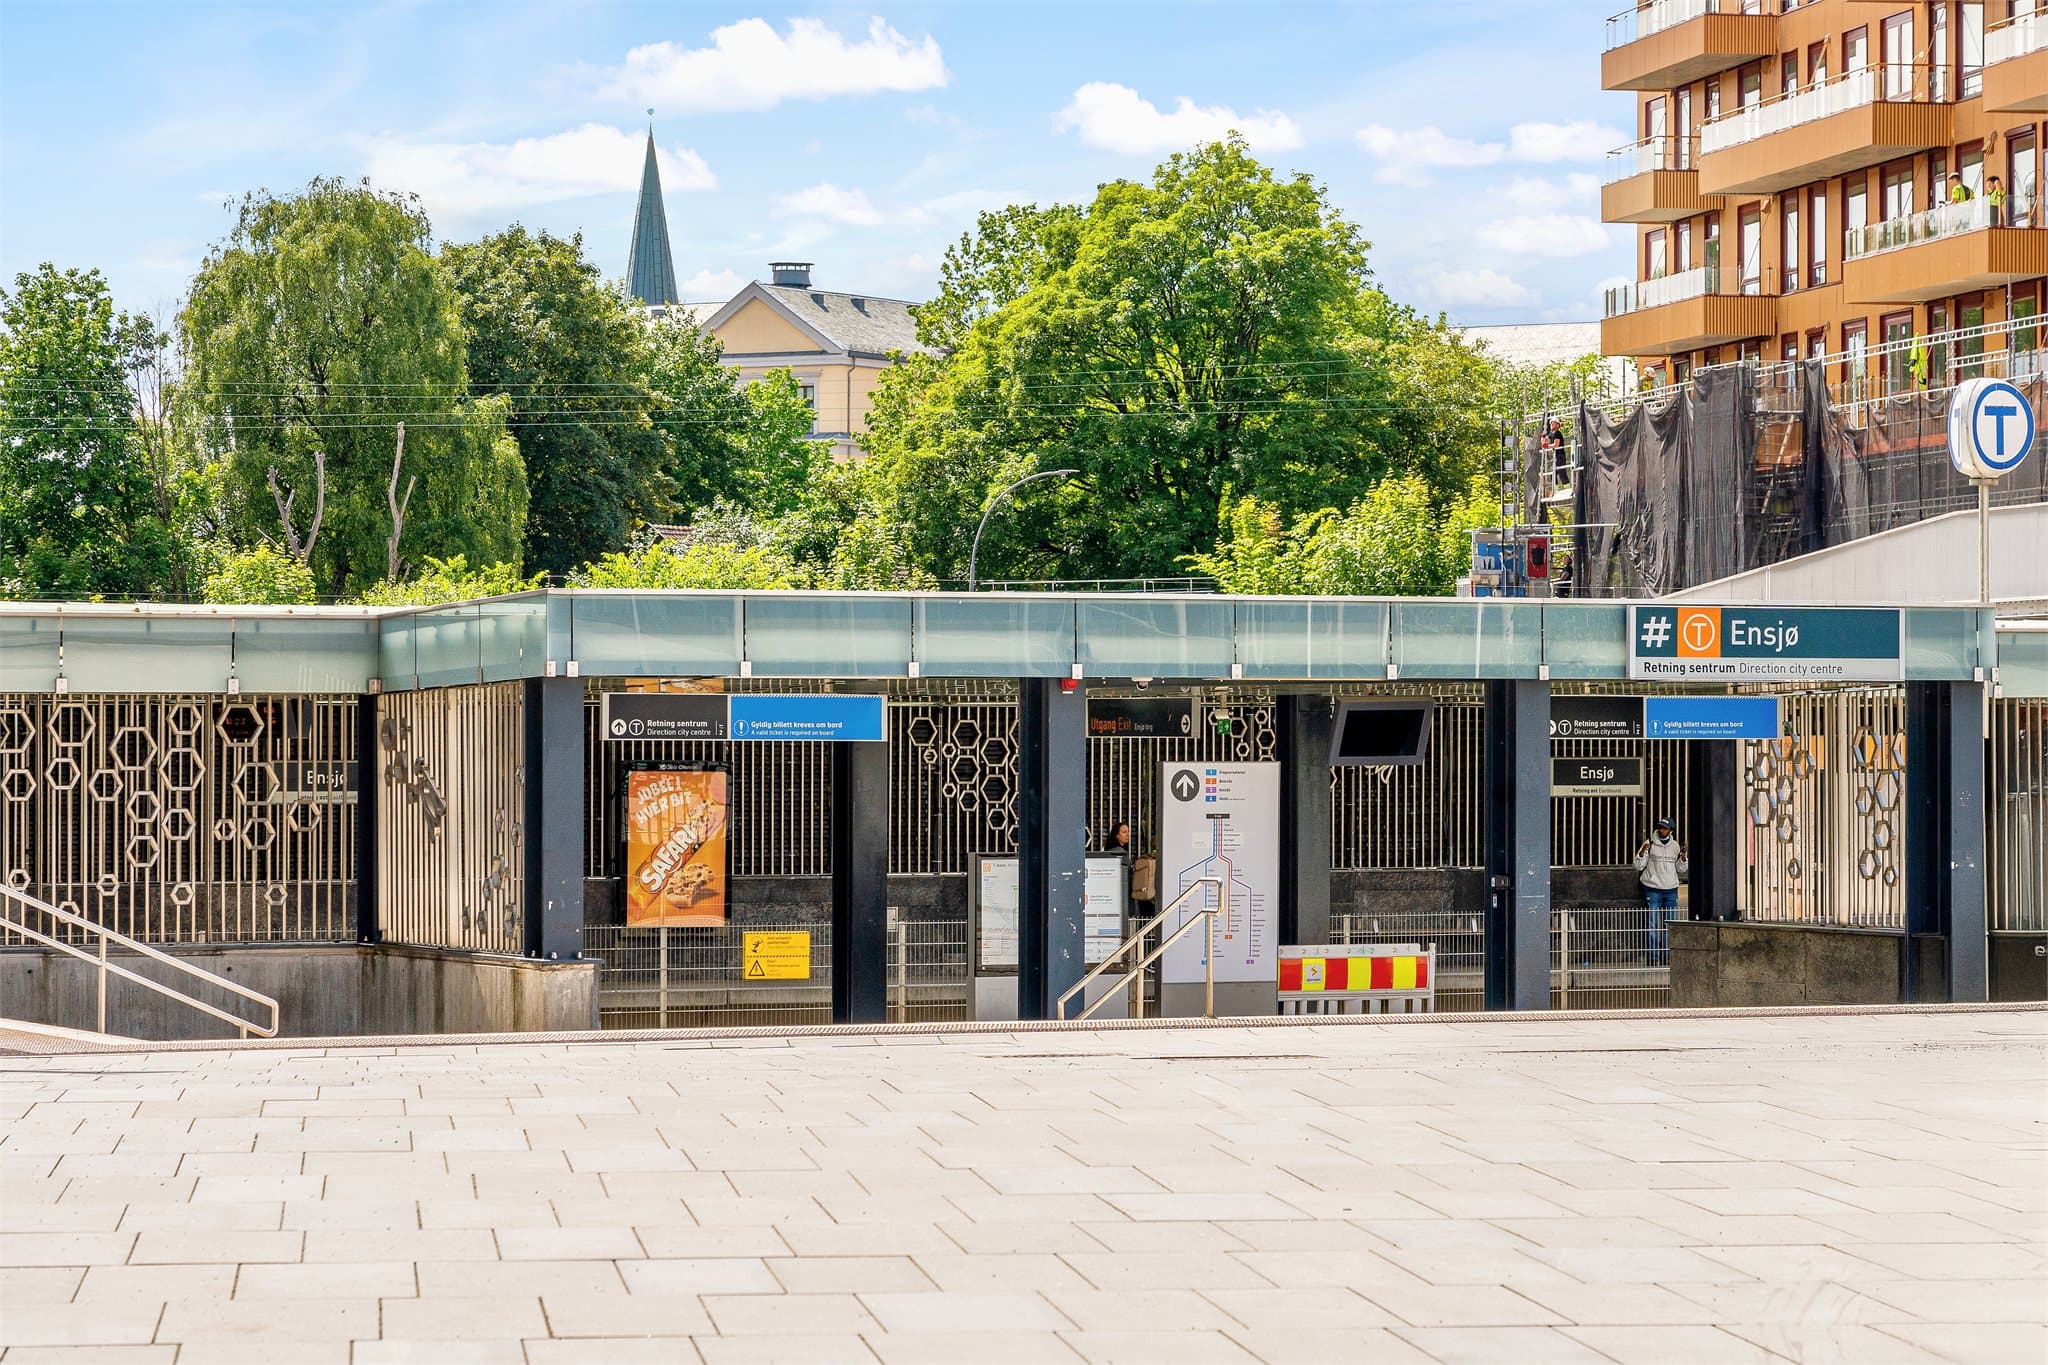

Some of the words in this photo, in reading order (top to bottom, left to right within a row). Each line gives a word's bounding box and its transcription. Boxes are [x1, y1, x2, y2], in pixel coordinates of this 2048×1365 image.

[1984, 406, 2017, 456] T
[1731, 619, 1799, 653] Ensjø
[1644, 662, 1686, 676] Retning
[1689, 662, 1736, 674] sentrum
[1739, 662, 1786, 674] Direction
[1789, 663, 1808, 676] city
[1810, 664, 1843, 674] centre
[647, 720, 676, 729] Retning
[750, 721, 772, 729] Gyldig
[1090, 717, 1116, 734] Utgang
[1118, 718, 1132, 730] Exit
[1580, 766, 1614, 782] Ensjø
[642, 822, 699, 892] SAFARI
